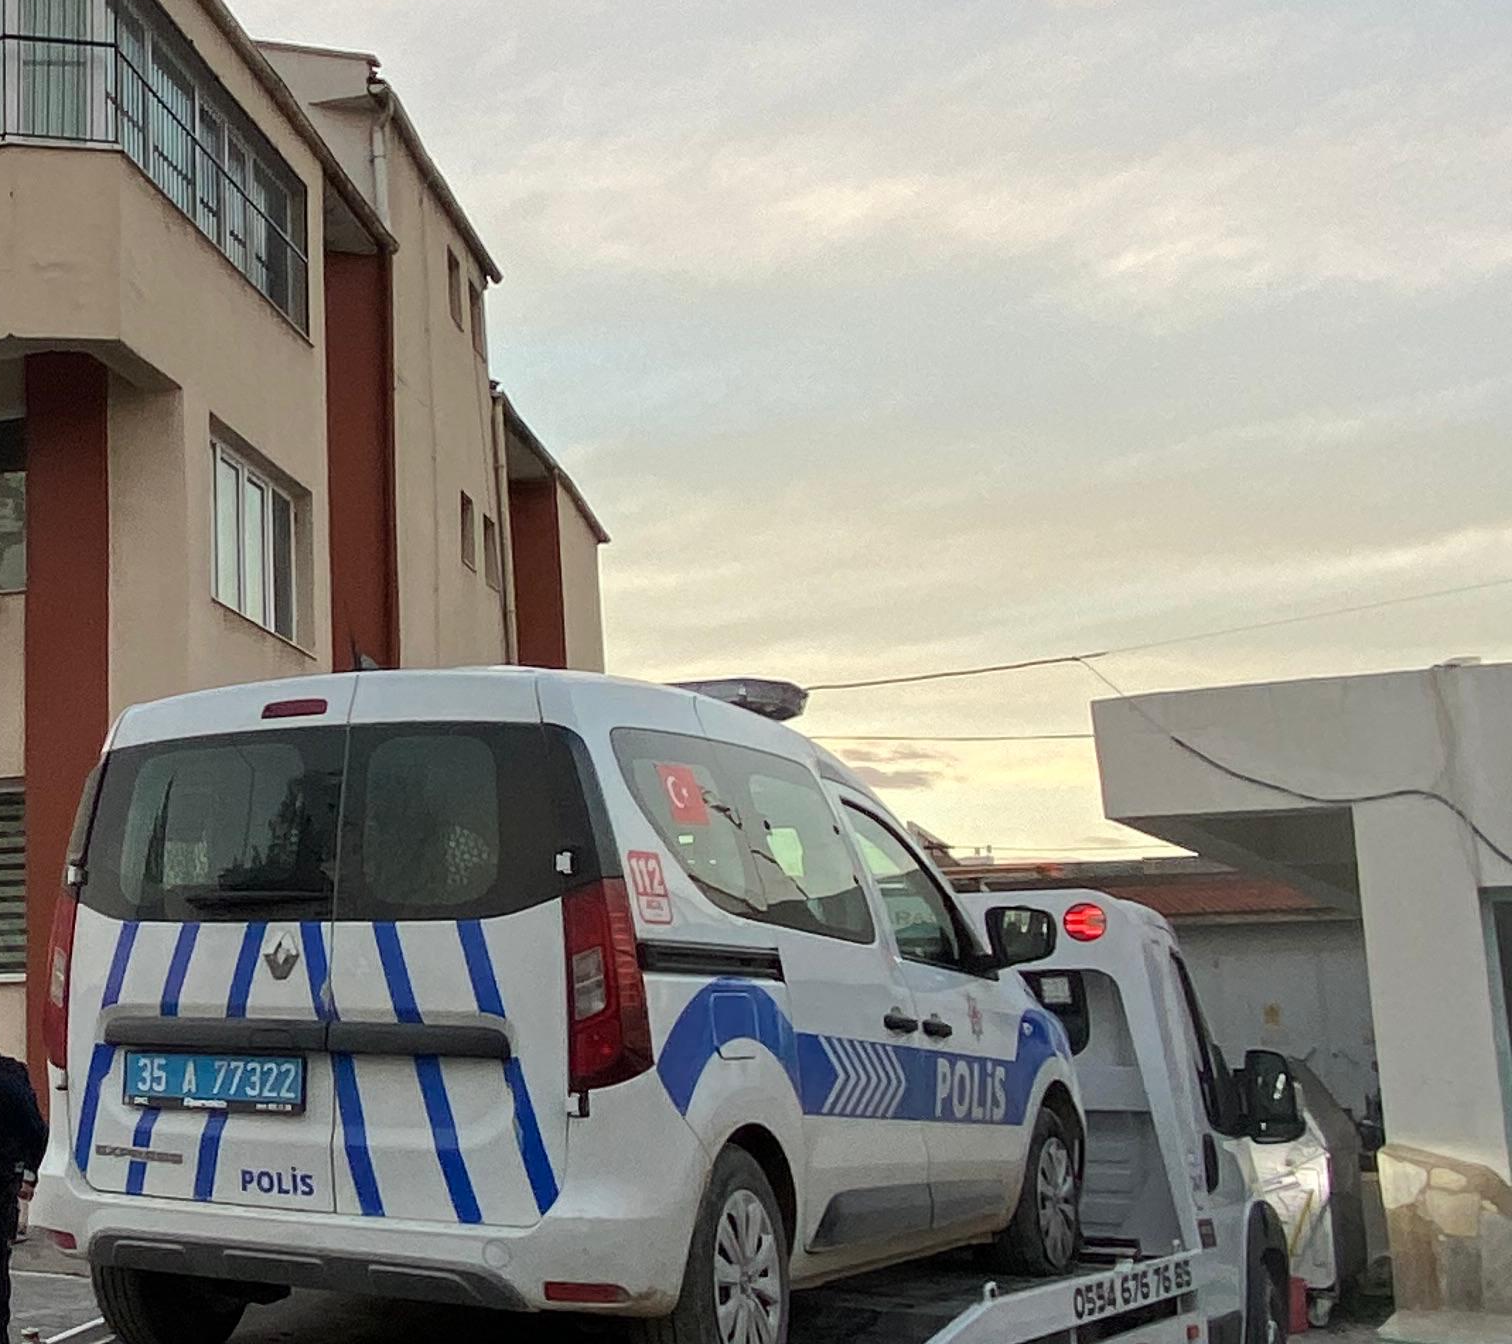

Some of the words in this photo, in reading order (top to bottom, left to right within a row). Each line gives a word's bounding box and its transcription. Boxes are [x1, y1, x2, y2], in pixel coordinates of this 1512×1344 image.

[137, 1057, 167, 1093] 35
[182, 1060, 197, 1094] A
[212, 1060, 296, 1099] 77322
[935, 1058, 1007, 1121] POLİS
[240, 1166, 315, 1197] POLİS
[1074, 1278, 1116, 1320] 0554
[1121, 1270, 1150, 1305] 676
[1153, 1264, 1172, 1297] 76
